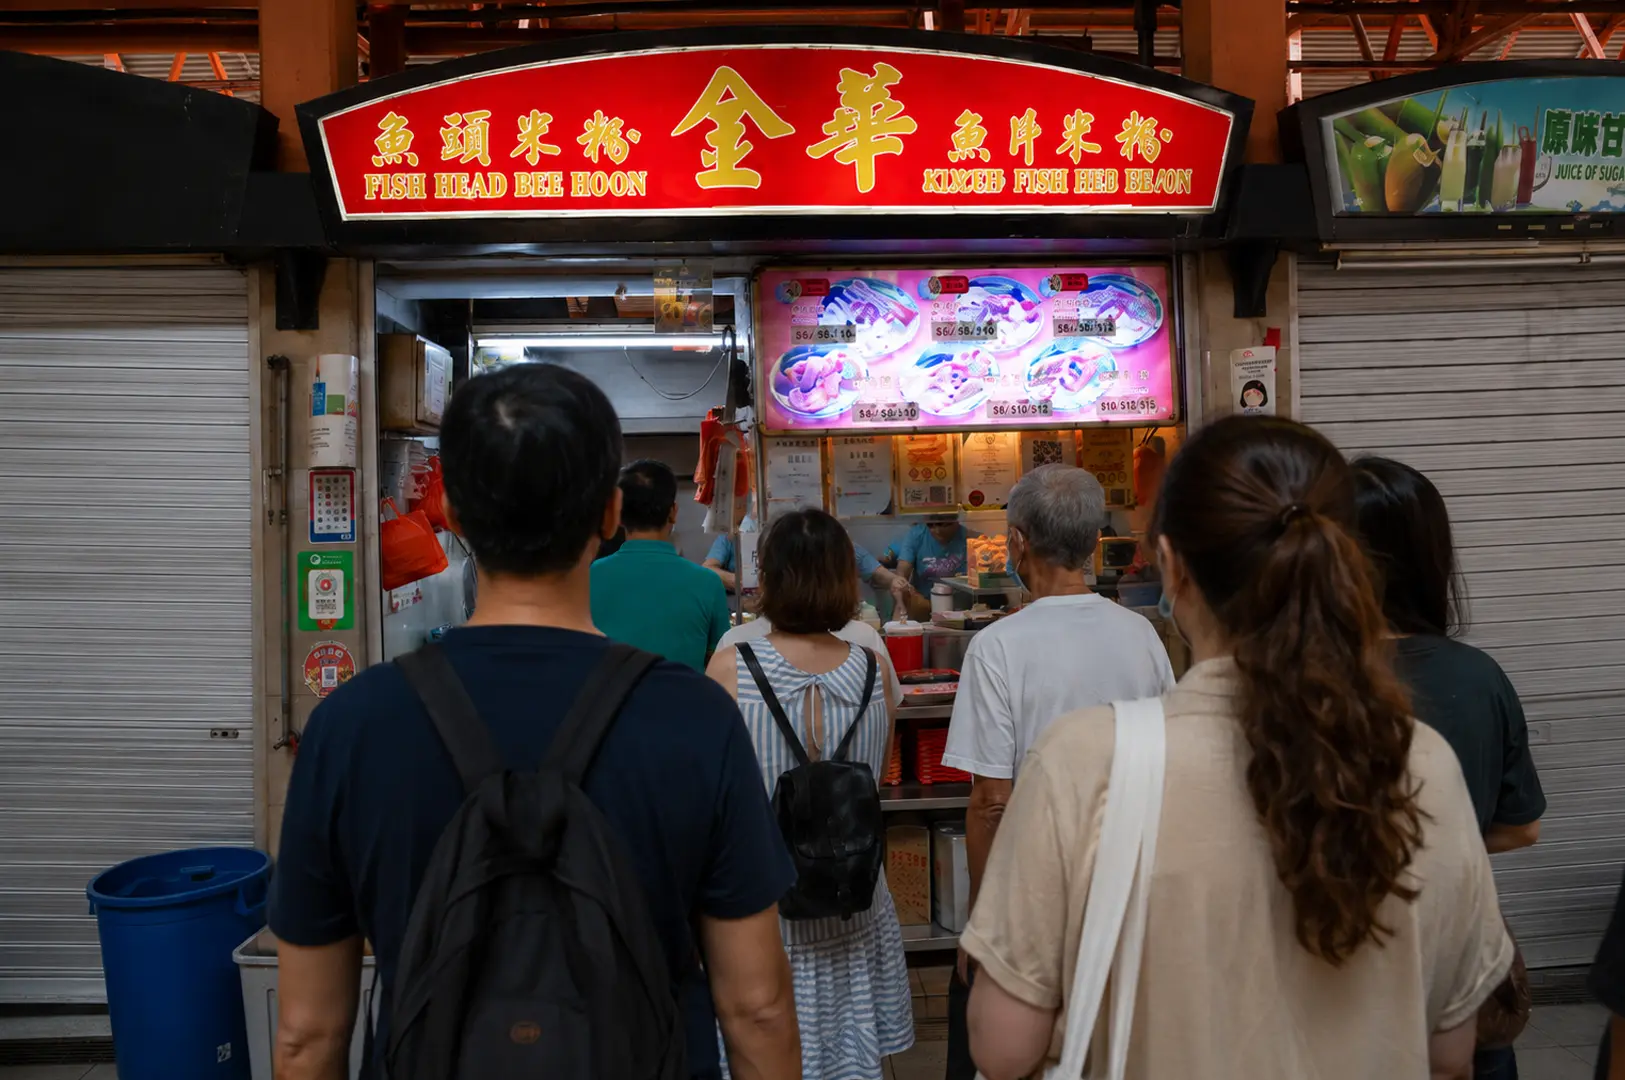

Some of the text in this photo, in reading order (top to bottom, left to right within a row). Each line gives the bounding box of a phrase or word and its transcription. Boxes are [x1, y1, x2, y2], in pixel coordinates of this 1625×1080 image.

[671, 62, 918, 193] 金華
[364, 170, 647, 199] FISH HEAD BEE HOON
[1013, 168, 1068, 194] FISH
[1554, 163, 1583, 180] JUICE
[1585, 164, 1598, 180] OF
